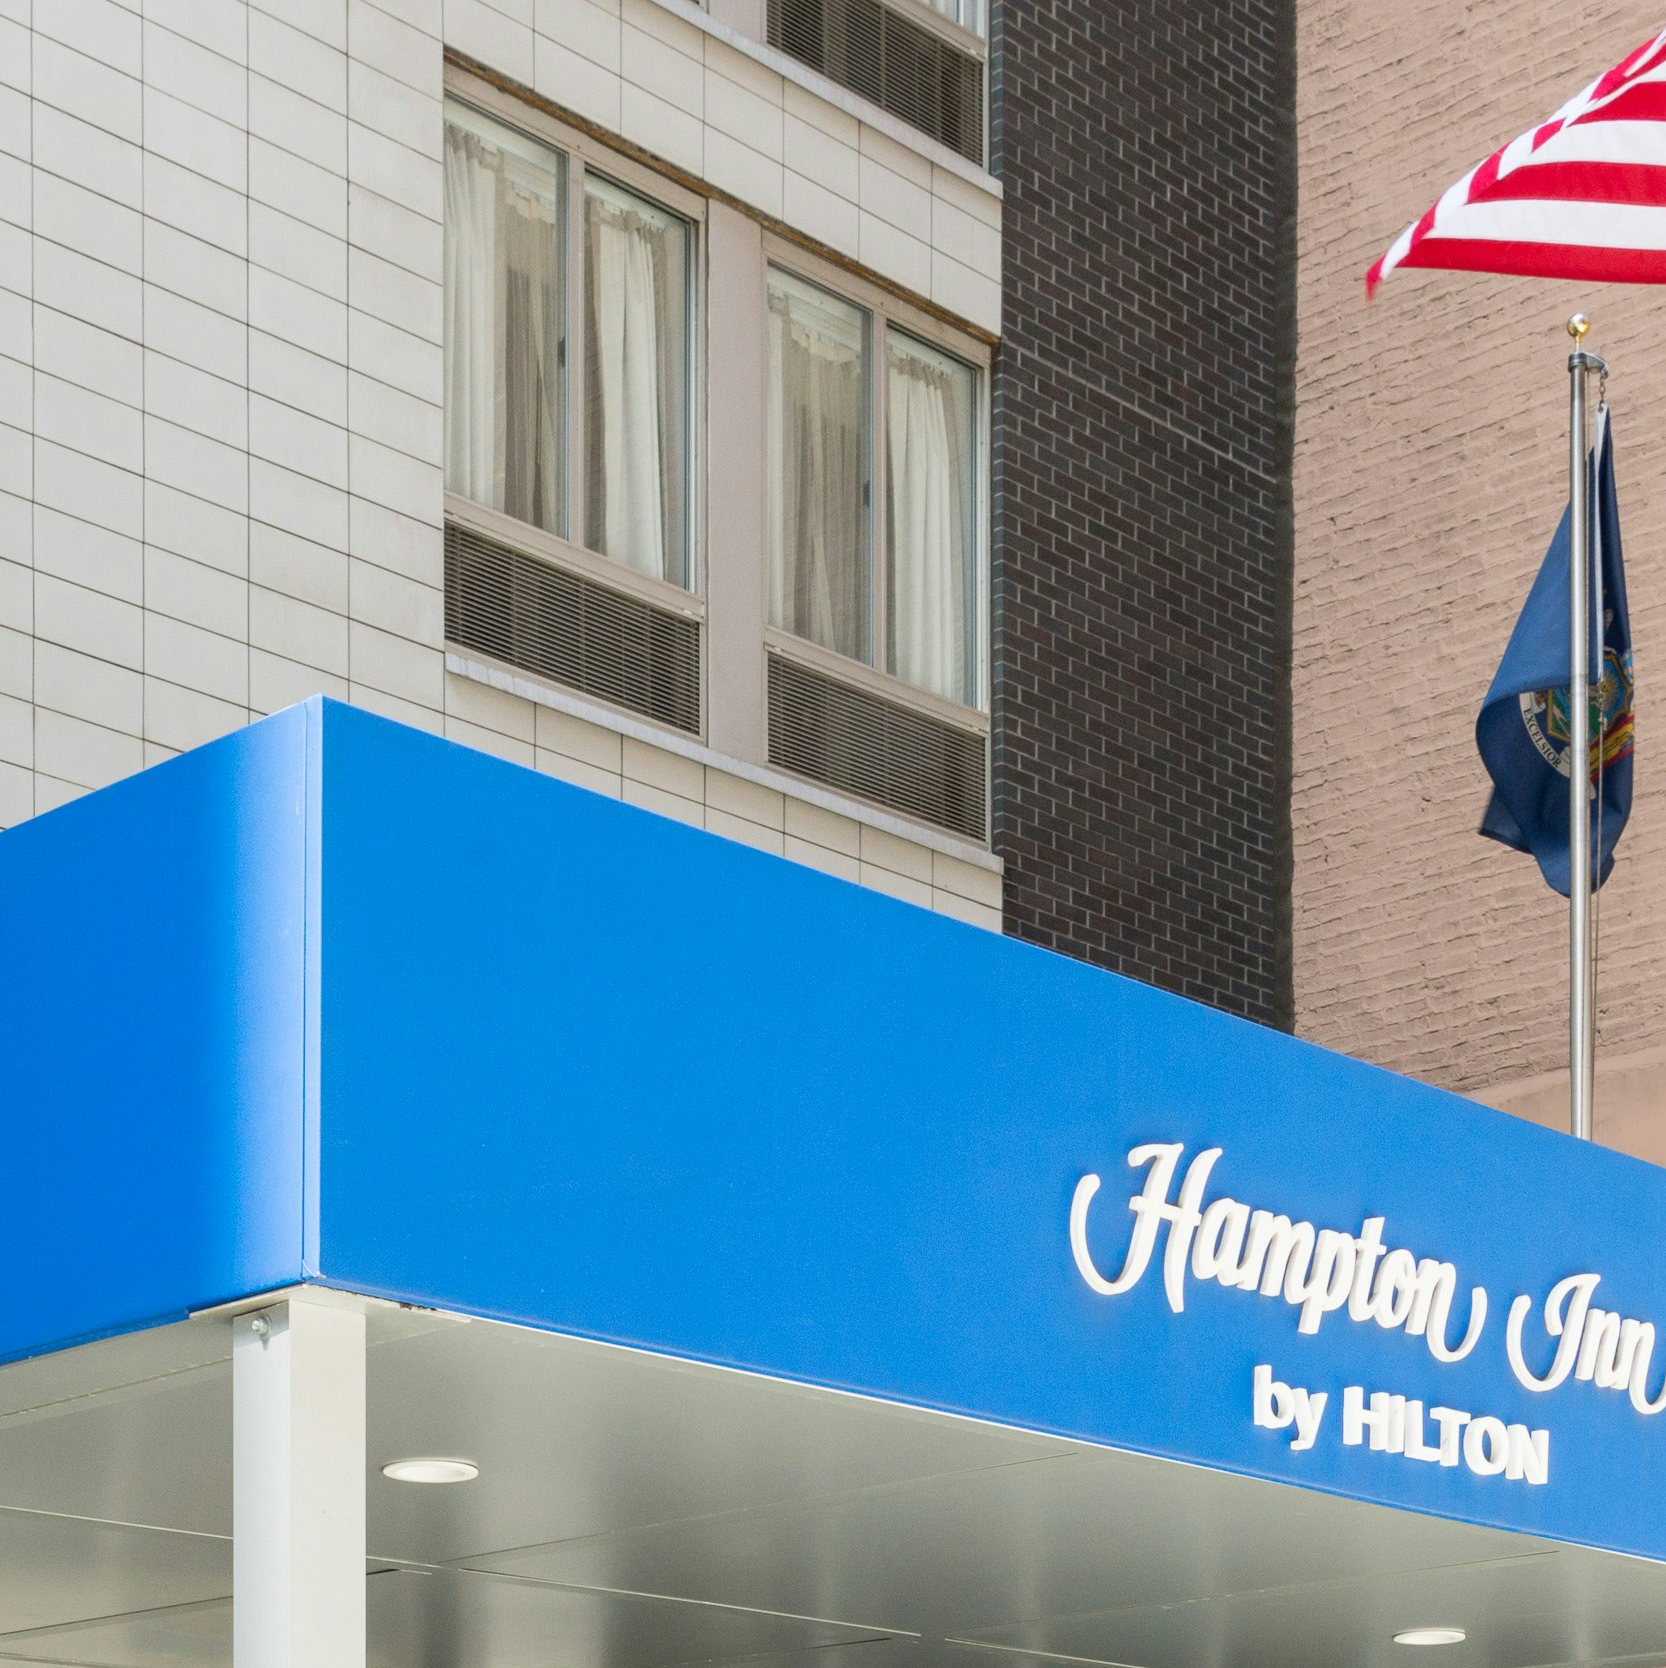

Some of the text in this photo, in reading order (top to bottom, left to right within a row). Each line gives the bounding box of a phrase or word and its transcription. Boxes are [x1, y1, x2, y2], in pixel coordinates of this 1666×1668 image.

[1523, 708, 1562, 768] EXCELSIOR
[1070, 1143, 1486, 1362] Hampton
[1253, 1364, 1550, 1485] by HILTON
